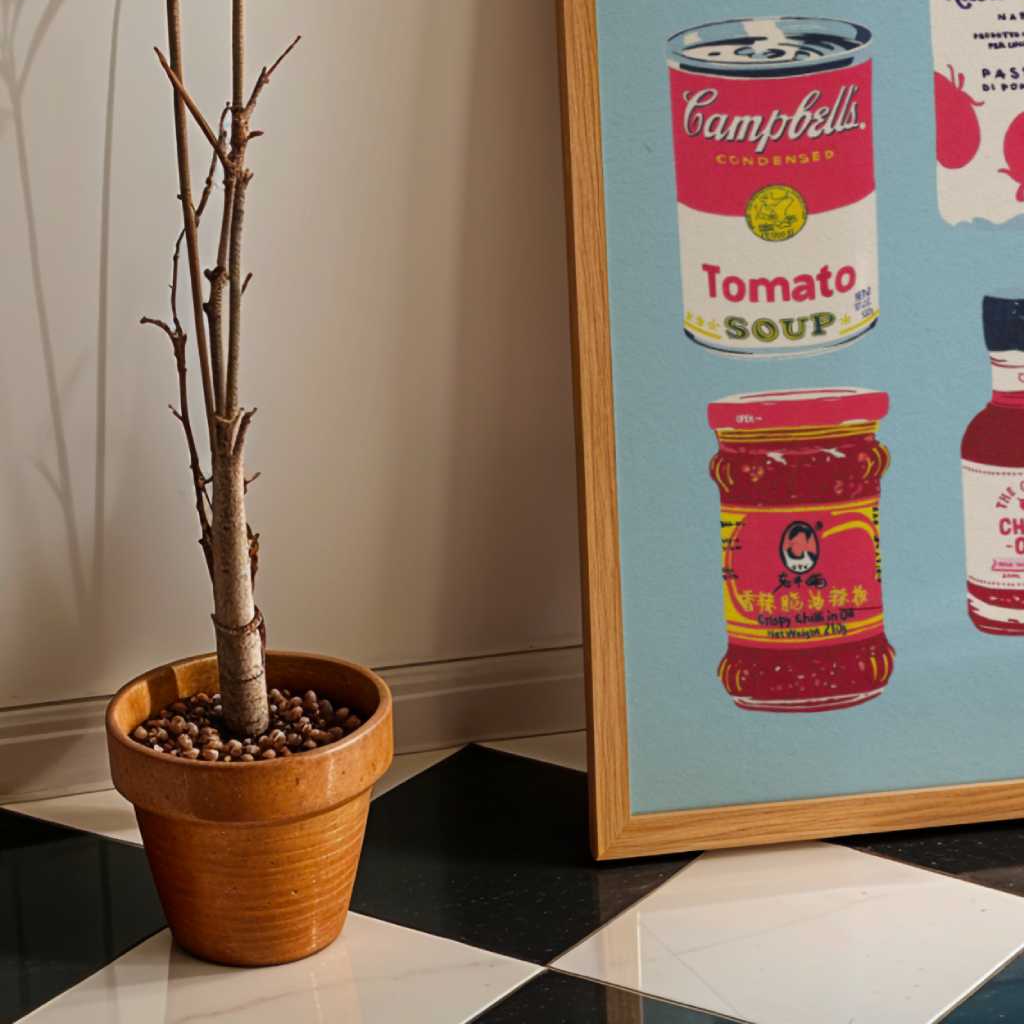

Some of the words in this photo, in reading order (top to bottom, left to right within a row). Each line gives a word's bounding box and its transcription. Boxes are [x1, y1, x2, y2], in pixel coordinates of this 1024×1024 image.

[982, 83, 996, 92] DI
[715, 149, 835, 167] CONDENSED
[701, 262, 858, 304] Tomato
[723, 311, 836, 343] SOUP
[994, 486, 1016, 509] THE
